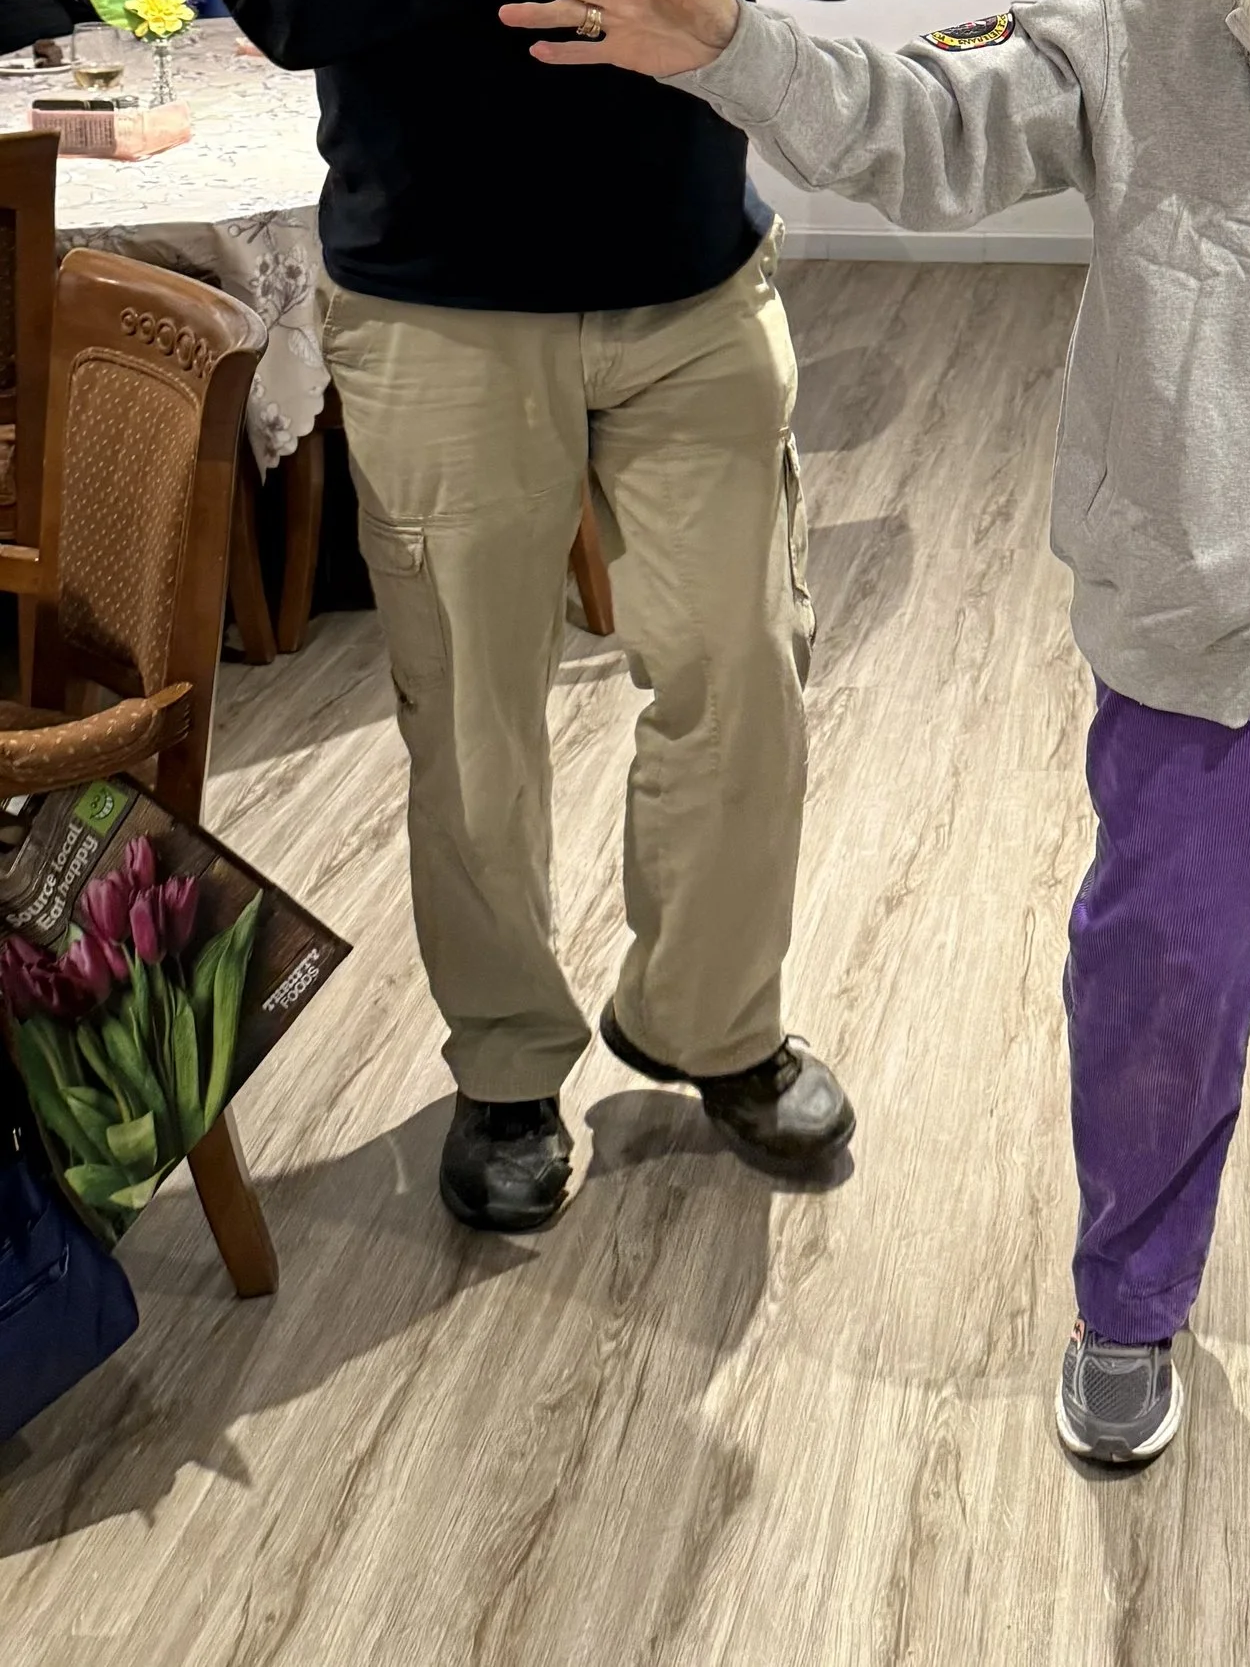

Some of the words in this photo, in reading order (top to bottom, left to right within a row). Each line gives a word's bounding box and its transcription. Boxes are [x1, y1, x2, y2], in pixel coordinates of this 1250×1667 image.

[5, 874, 57, 928] Source
[51, 823, 84, 872] local
[36, 896, 66, 931] Eat
[58, 834, 98, 897] happy
[280, 966, 319, 1009] FOODS
